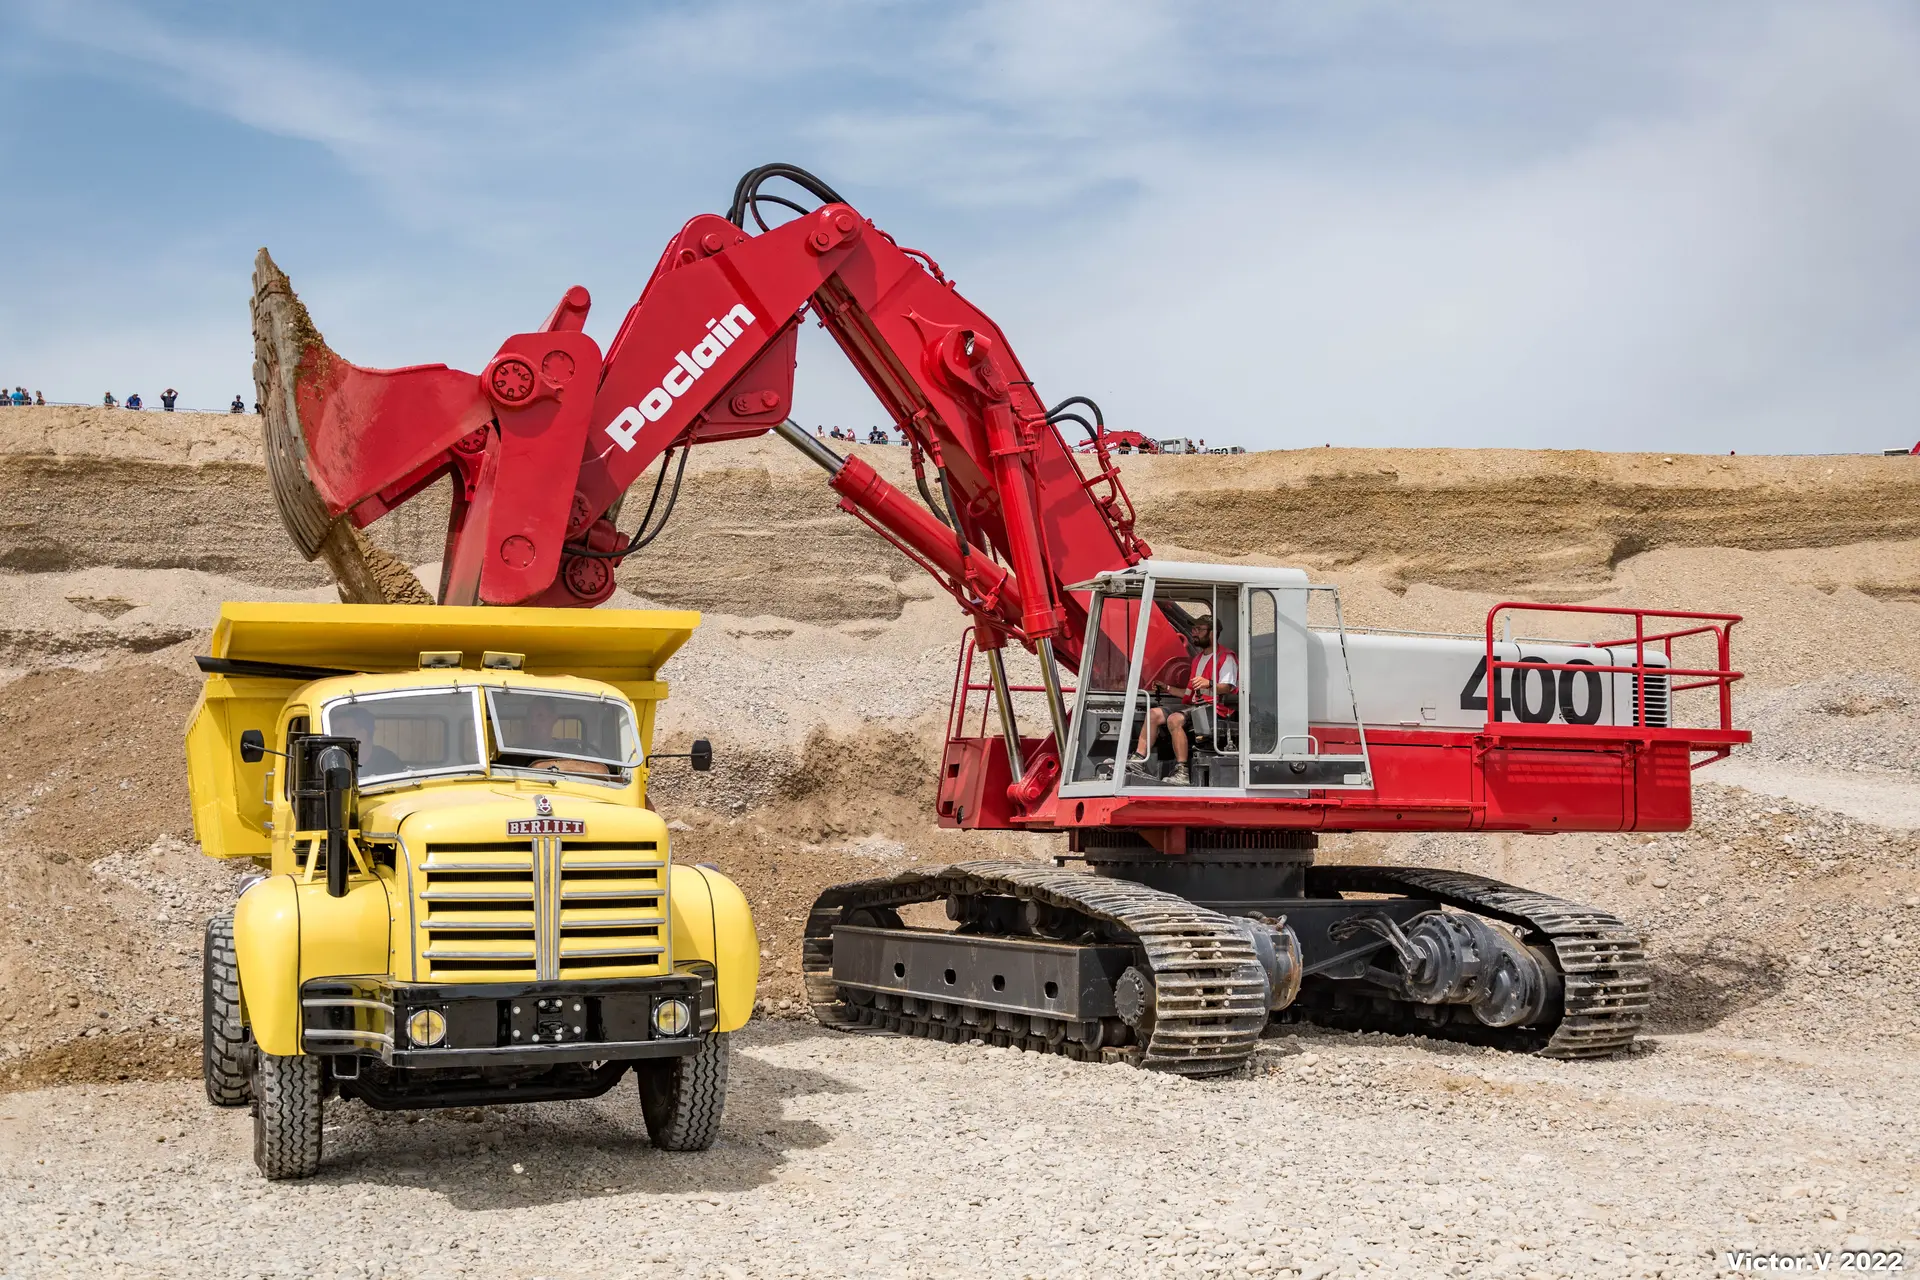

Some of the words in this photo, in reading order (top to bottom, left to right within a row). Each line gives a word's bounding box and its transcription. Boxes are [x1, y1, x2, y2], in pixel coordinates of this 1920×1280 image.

[604, 303, 757, 453] Poclain
[1460, 655, 1603, 726] 400
[509, 820, 582, 834] BERLIET
